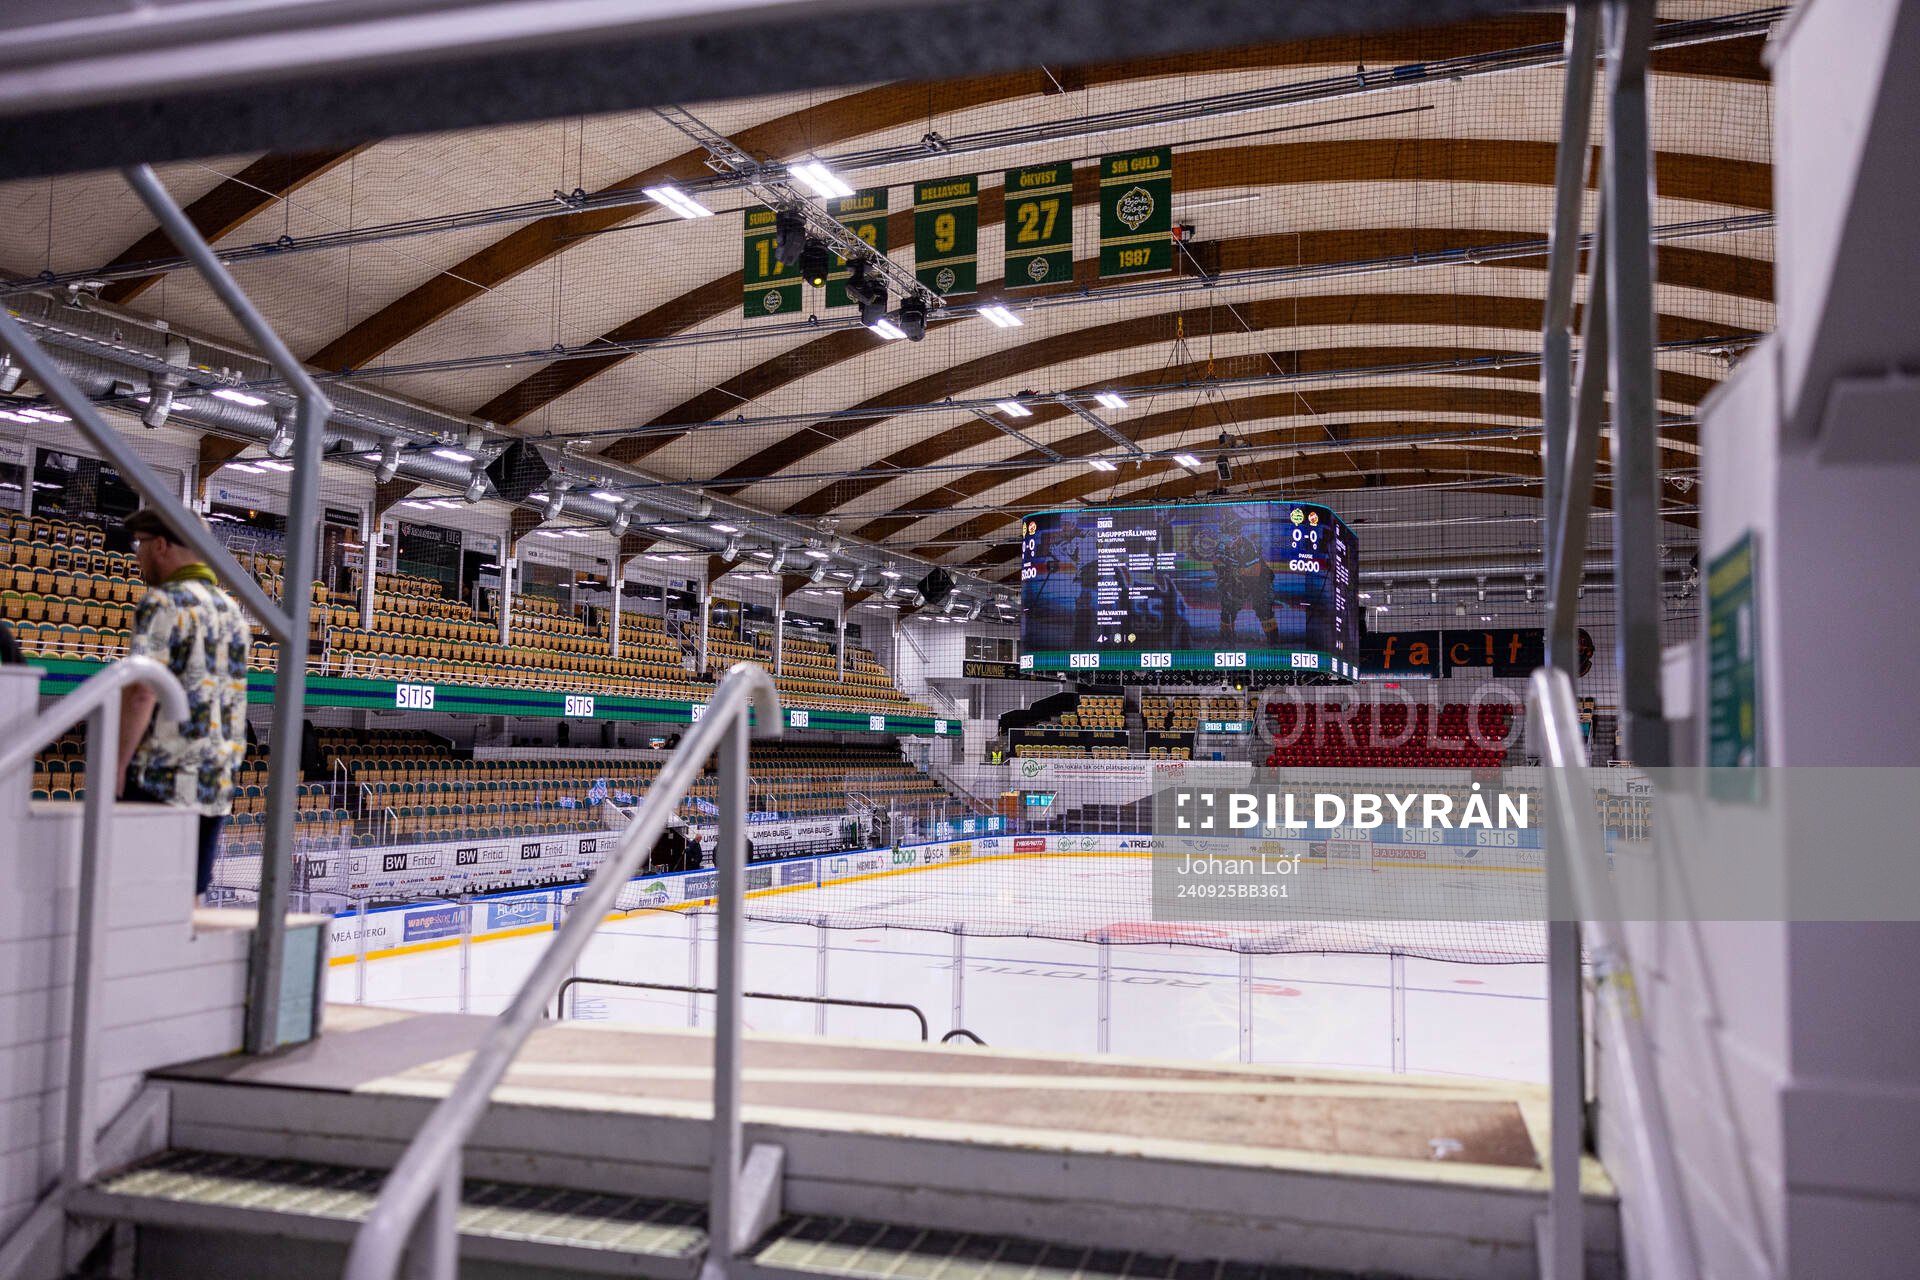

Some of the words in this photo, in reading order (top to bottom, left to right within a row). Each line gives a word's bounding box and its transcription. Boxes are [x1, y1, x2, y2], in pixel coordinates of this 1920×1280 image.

[1111, 159, 1129, 174] SM
[1130, 155, 1160, 171] GULD
[1019, 169, 1057, 187] ÖKVIST
[749, 211, 777, 225] SUNDS
[1017, 199, 1060, 243] 27
[934, 212, 956, 252] 9
[1119, 248, 1151, 268] 1987
[1097, 530, 1157, 538] LAGUPPSTÄLLNING
[1289, 559, 1320, 573] 60:00
[1072, 655, 1098, 667] STS
[1142, 654, 1170, 666] STS
[1216, 654, 1245, 666] STS
[1293, 654, 1317, 667] STS
[398, 686, 433, 707] STS
[566, 697, 593, 715] STS
[791, 713, 808, 726] STS
[870, 717, 884, 729] STS
[1156, 762, 1184, 773] Haga
[1334, 828, 1367, 840] STS
[1405, 829, 1441, 843] STS
[1479, 832, 1515, 845] STS
[580, 841, 596, 853] BW
[982, 839, 999, 849] STENA
[1128, 840, 1165, 849] TREJON
[458, 850, 477, 864] BW
[482, 849, 503, 860] Fritid
[523, 845, 540, 858] BW
[545, 844, 563, 855] Fritid
[932, 848, 944, 859] SCA
[1373, 849, 1426, 859] BAUHAUS
[385, 855, 406, 871] BW
[412, 855, 436, 866] Fritid
[354, 927, 386, 939] ENERGI
